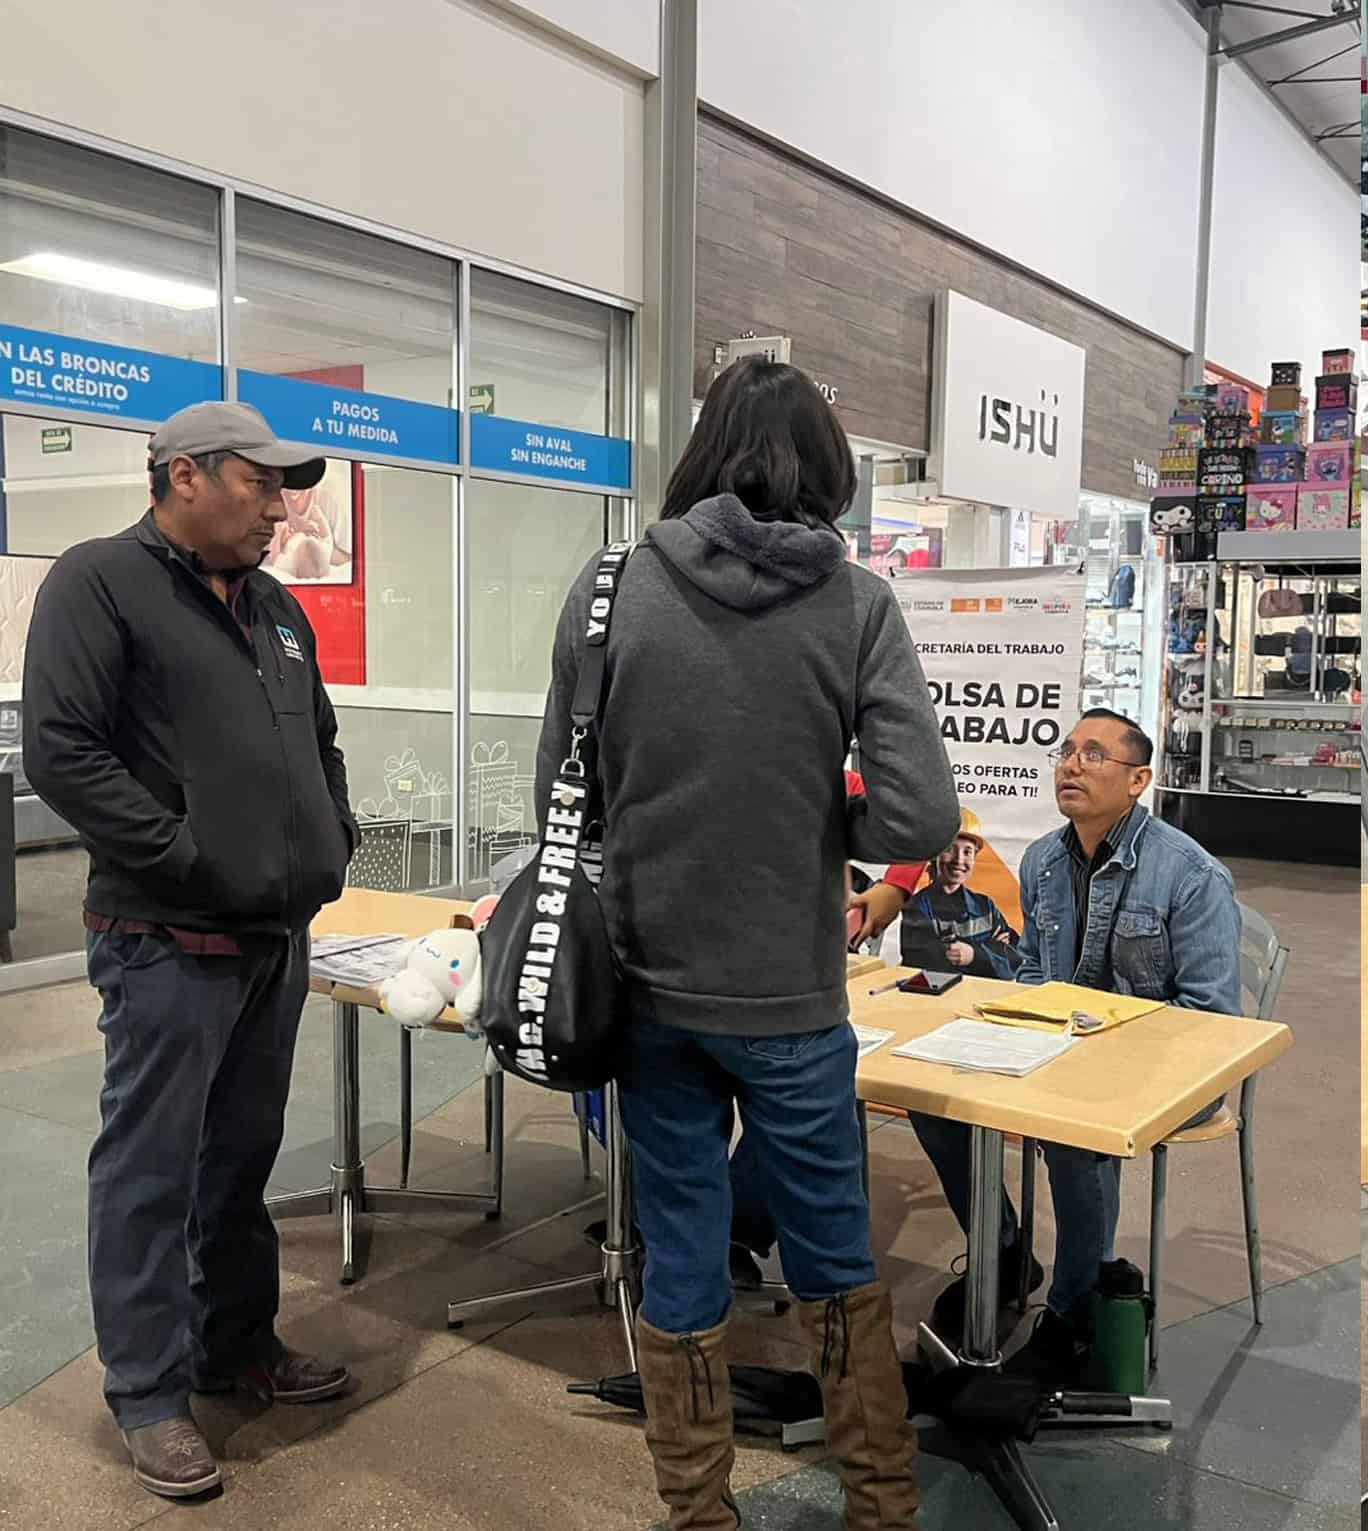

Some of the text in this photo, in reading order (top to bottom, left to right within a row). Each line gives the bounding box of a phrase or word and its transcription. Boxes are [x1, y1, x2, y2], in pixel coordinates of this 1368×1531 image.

[19, 344, 55, 366] LAS
[61, 351, 151, 383] BRONCAS
[11, 367, 46, 389] DEL
[51, 373, 128, 401] CRÉDITO
[332, 399, 380, 422] PAGOS
[312, 417, 399, 444] A TU MEDIDA
[526, 433, 572, 453] SIN AVAL
[511, 447, 587, 471] SIN ENGANCHE
[914, 641, 1065, 655] CRETARÍA DEL TRABAJO
[927, 681, 1062, 710] OLSA DE
[941, 715, 1061, 746] ABAJO
[974, 765, 1039, 779] OFERTAS
[980, 783, 1017, 797] PARA
[1022, 786, 1039, 798] TI!
[538, 807, 583, 888] FREE
[536, 889, 569, 916] &
[518, 922, 561, 1013] WILD
